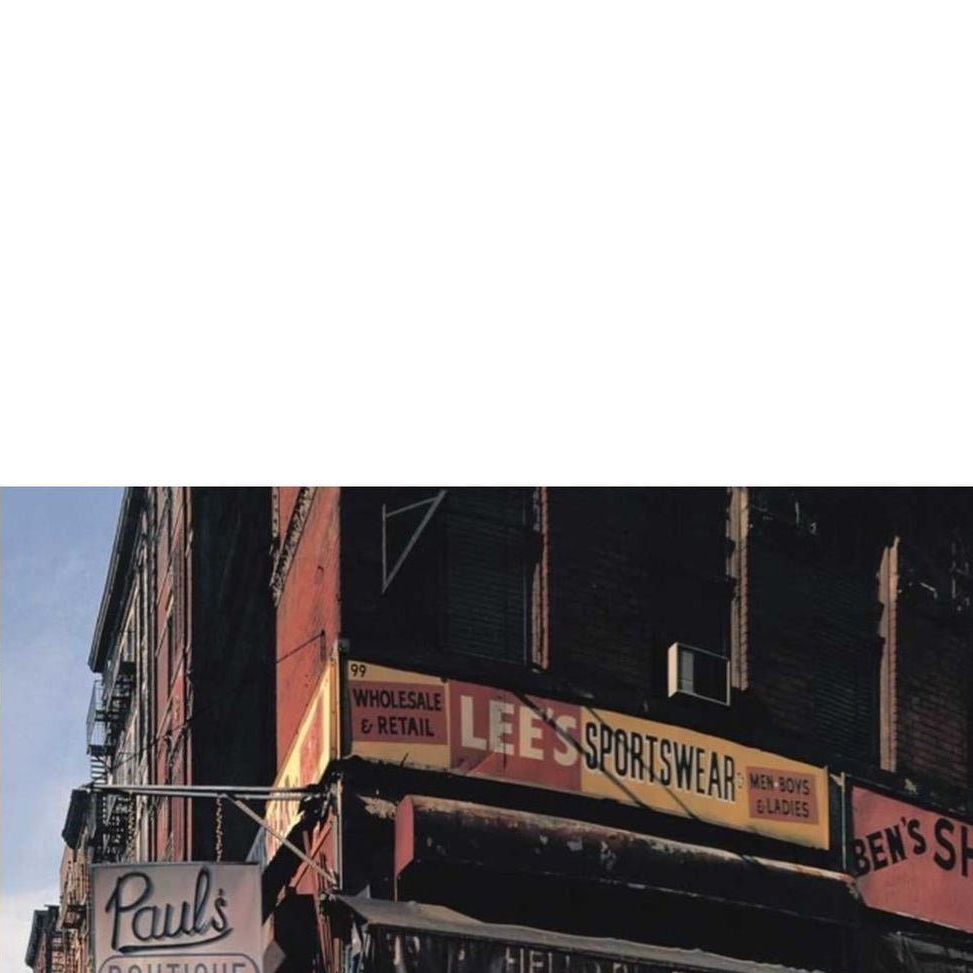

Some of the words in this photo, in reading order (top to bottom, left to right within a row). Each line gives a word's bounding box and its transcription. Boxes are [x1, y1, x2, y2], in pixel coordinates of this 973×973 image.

[350, 662, 367, 678] 99
[352, 688, 443, 712] WHOLESALE
[378, 715, 435, 737] RETAIL
[459, 694, 577, 767] LEE'S
[583, 721, 736, 803] SPORTSWEAR
[749, 772, 774, 790] MEN
[779, 775, 811, 796] BOYS
[852, 816, 927, 878] BEN'S
[105, 866, 231, 953] Paul's
